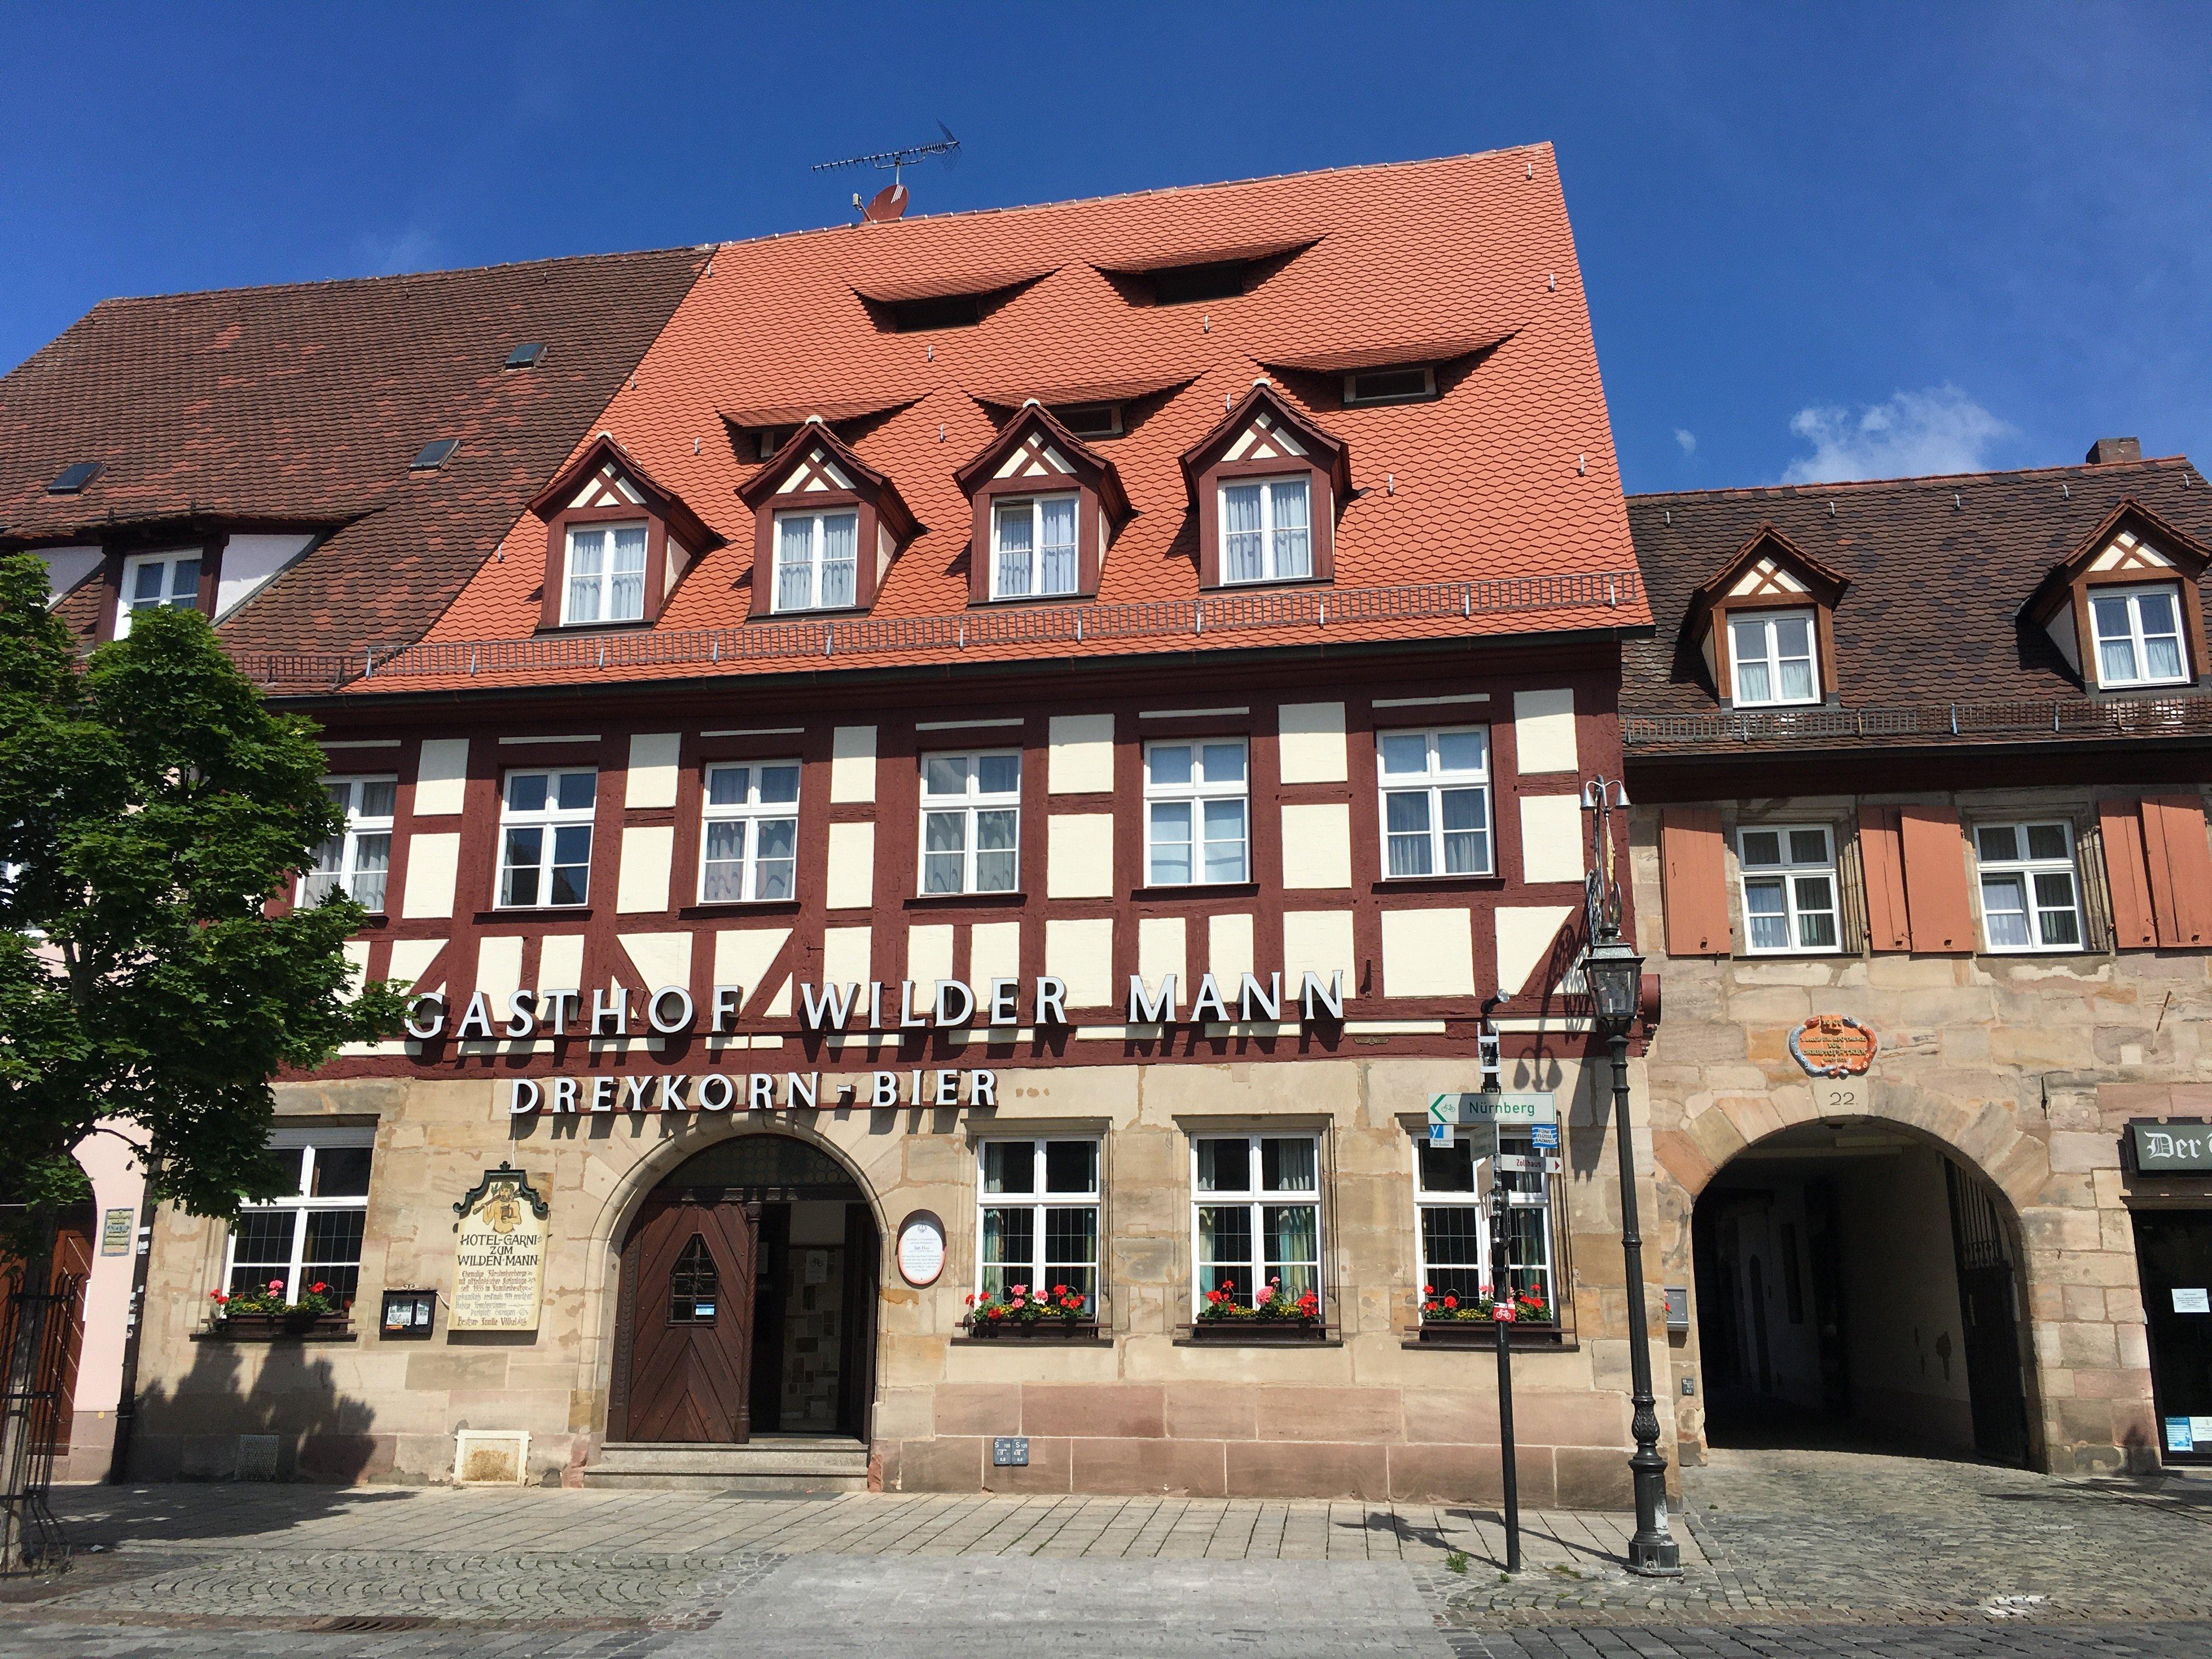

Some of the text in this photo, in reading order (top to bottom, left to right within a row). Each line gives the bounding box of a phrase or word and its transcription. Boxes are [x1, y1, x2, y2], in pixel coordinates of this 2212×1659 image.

[404, 969, 1344, 1039] GASTHOF WILDER MANN
[1469, 1102, 1534, 1116] Nürnberg
[2144, 1131, 2202, 1159] Der
[1516, 1159, 1542, 1168] Zollhaus
[460, 1234, 537, 1248] HOTEL-GARNI
[490, 1246, 513, 1255] ZUM
[457, 1254, 538, 1266] WILDEN MANN
[457, 1316, 478, 1327] Besitzer
[481, 1317, 498, 1326] Familie
